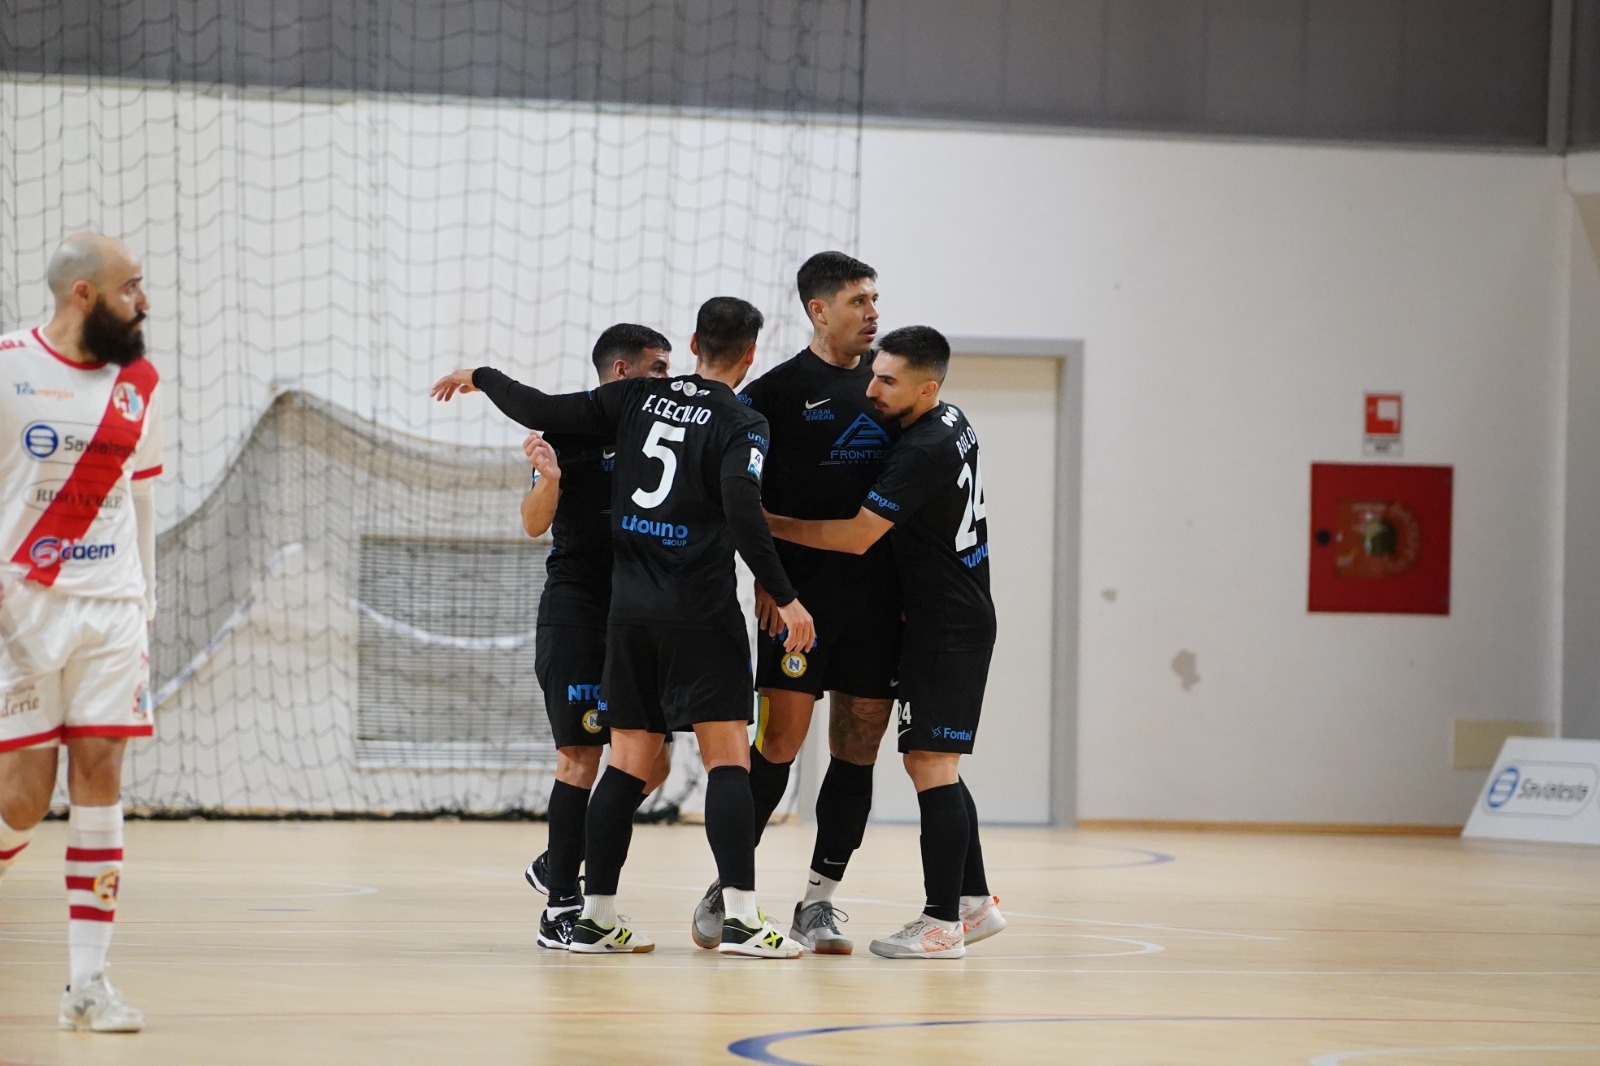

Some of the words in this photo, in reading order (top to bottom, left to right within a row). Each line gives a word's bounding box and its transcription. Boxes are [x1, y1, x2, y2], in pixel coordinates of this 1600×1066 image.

[641, 394, 712, 425] F.CECILIO
[631, 420, 686, 509] 5
[662, 538, 688, 547] GROUP
[943, 727, 973, 741] Fontel
